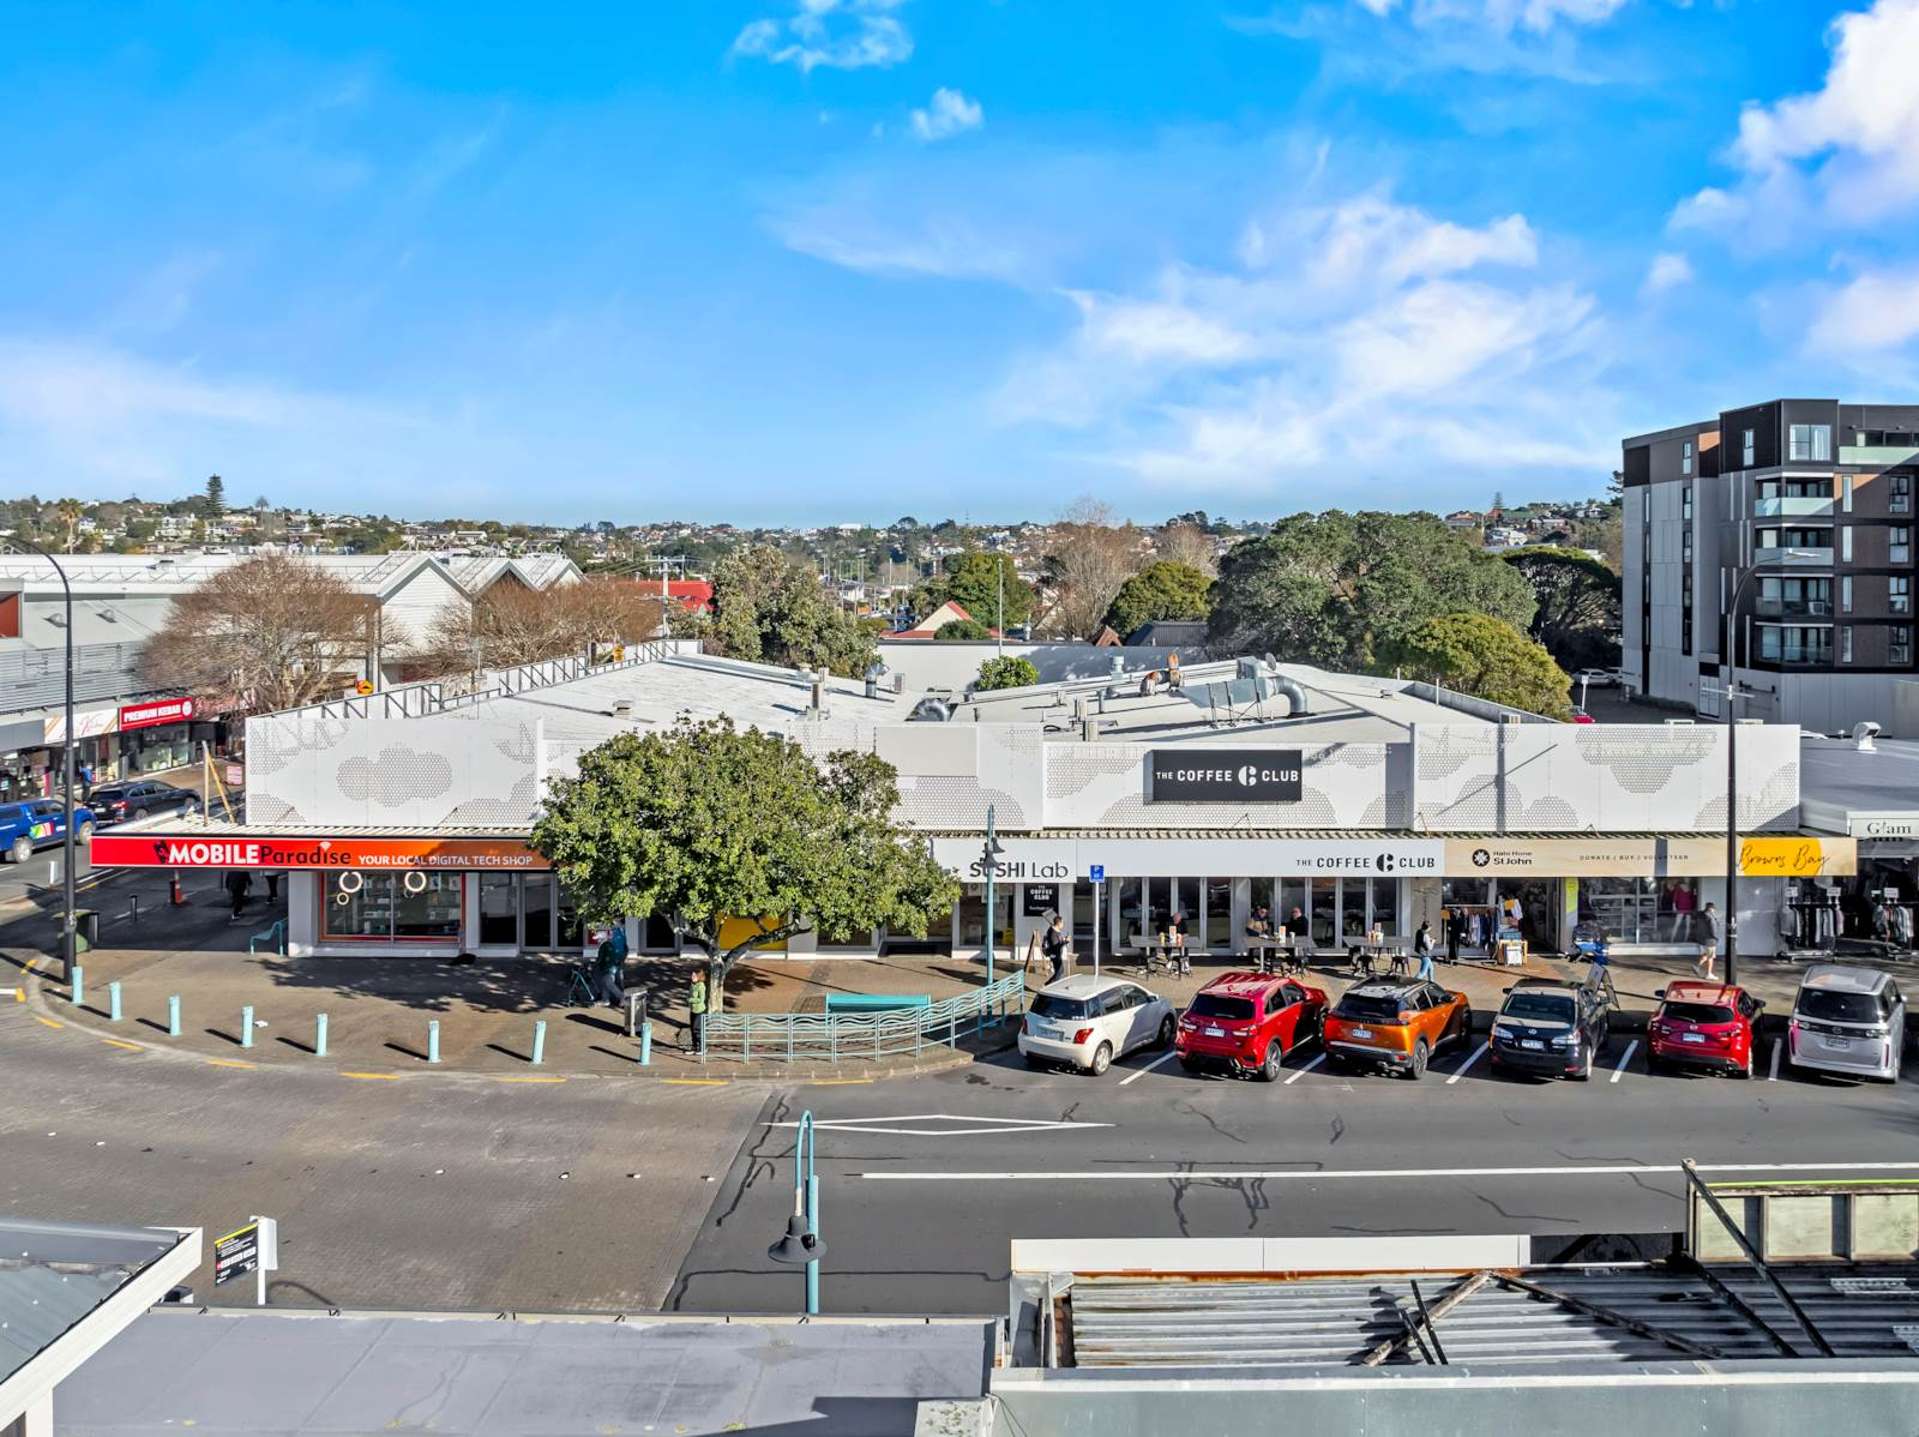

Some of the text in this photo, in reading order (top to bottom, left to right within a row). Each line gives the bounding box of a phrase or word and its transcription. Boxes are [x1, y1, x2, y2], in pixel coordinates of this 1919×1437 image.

[123, 708, 158, 723] PREMIUM
[158, 704, 182, 718] KEBAB
[1155, 771, 1174, 780] THE
[1177, 769, 1233, 782] COFFEE
[1261, 769, 1299, 782] CLUB
[1867, 821, 1912, 835] Glam
[168, 843, 352, 865] MOBILE Paradise
[358, 854, 534, 866] YOUR LOCAL DIGITAL TECH SHOP
[1493, 857, 1533, 865] St John
[1738, 844, 1831, 875] Browns Bay
[1031, 861, 1069, 878] Lab
[1295, 858, 1312, 867] THE
[1316, 856, 1371, 869] COFFEE
[1399, 856, 1435, 869] CLUB
